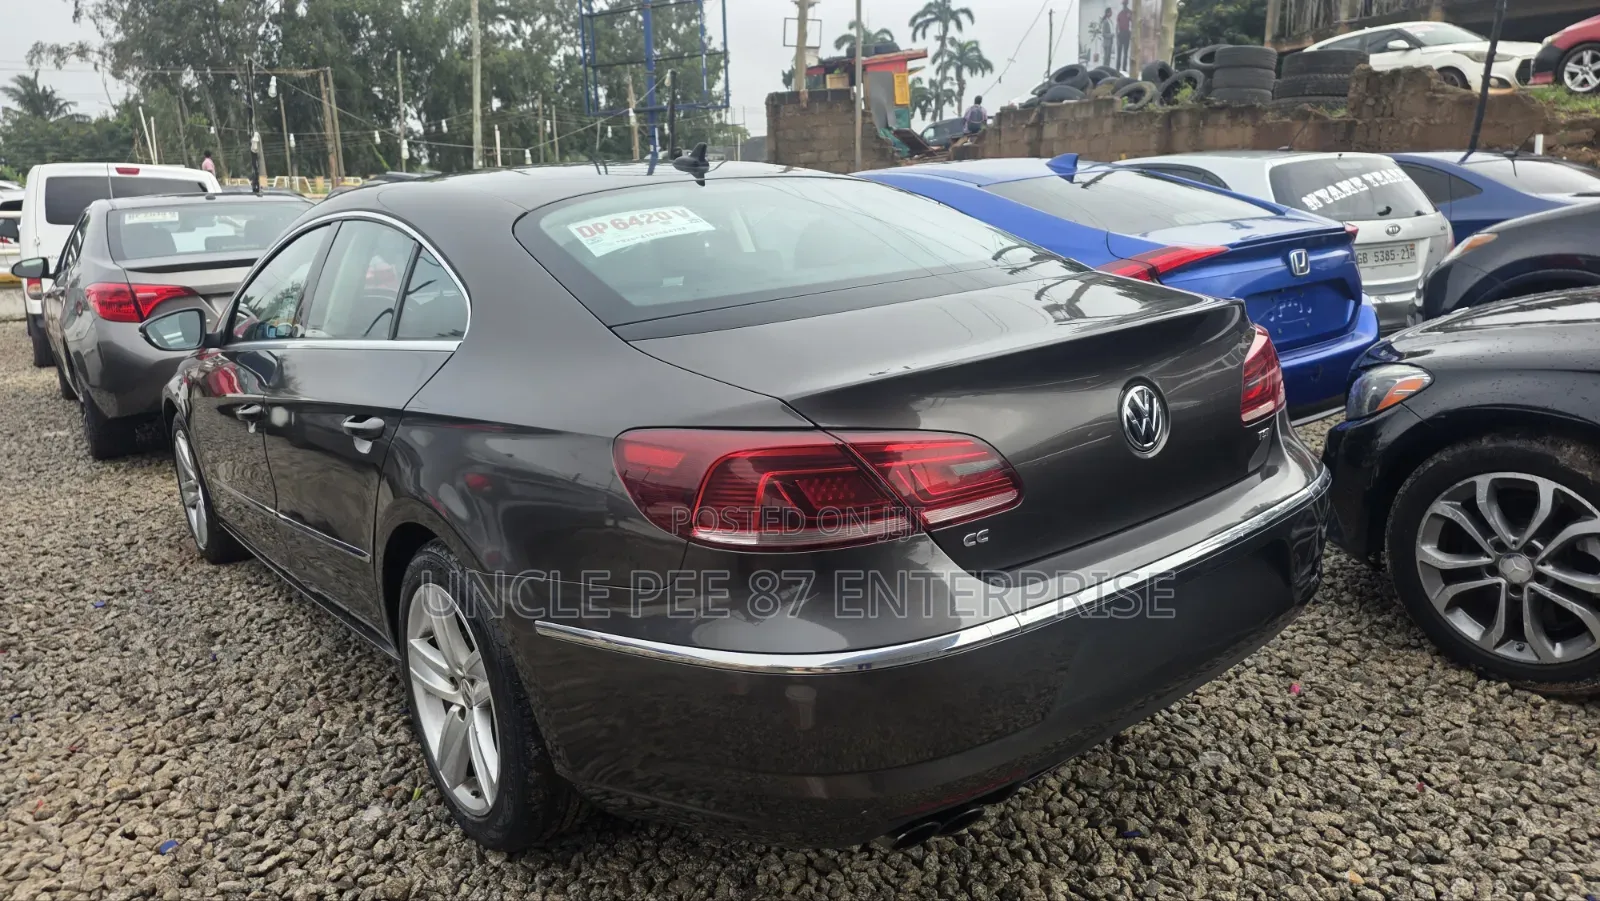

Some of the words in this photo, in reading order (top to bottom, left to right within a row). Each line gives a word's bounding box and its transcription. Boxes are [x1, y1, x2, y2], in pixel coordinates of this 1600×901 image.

[575, 221, 608, 239] DP
[610, 211, 672, 231] 6420
[963, 528, 989, 547] CC
